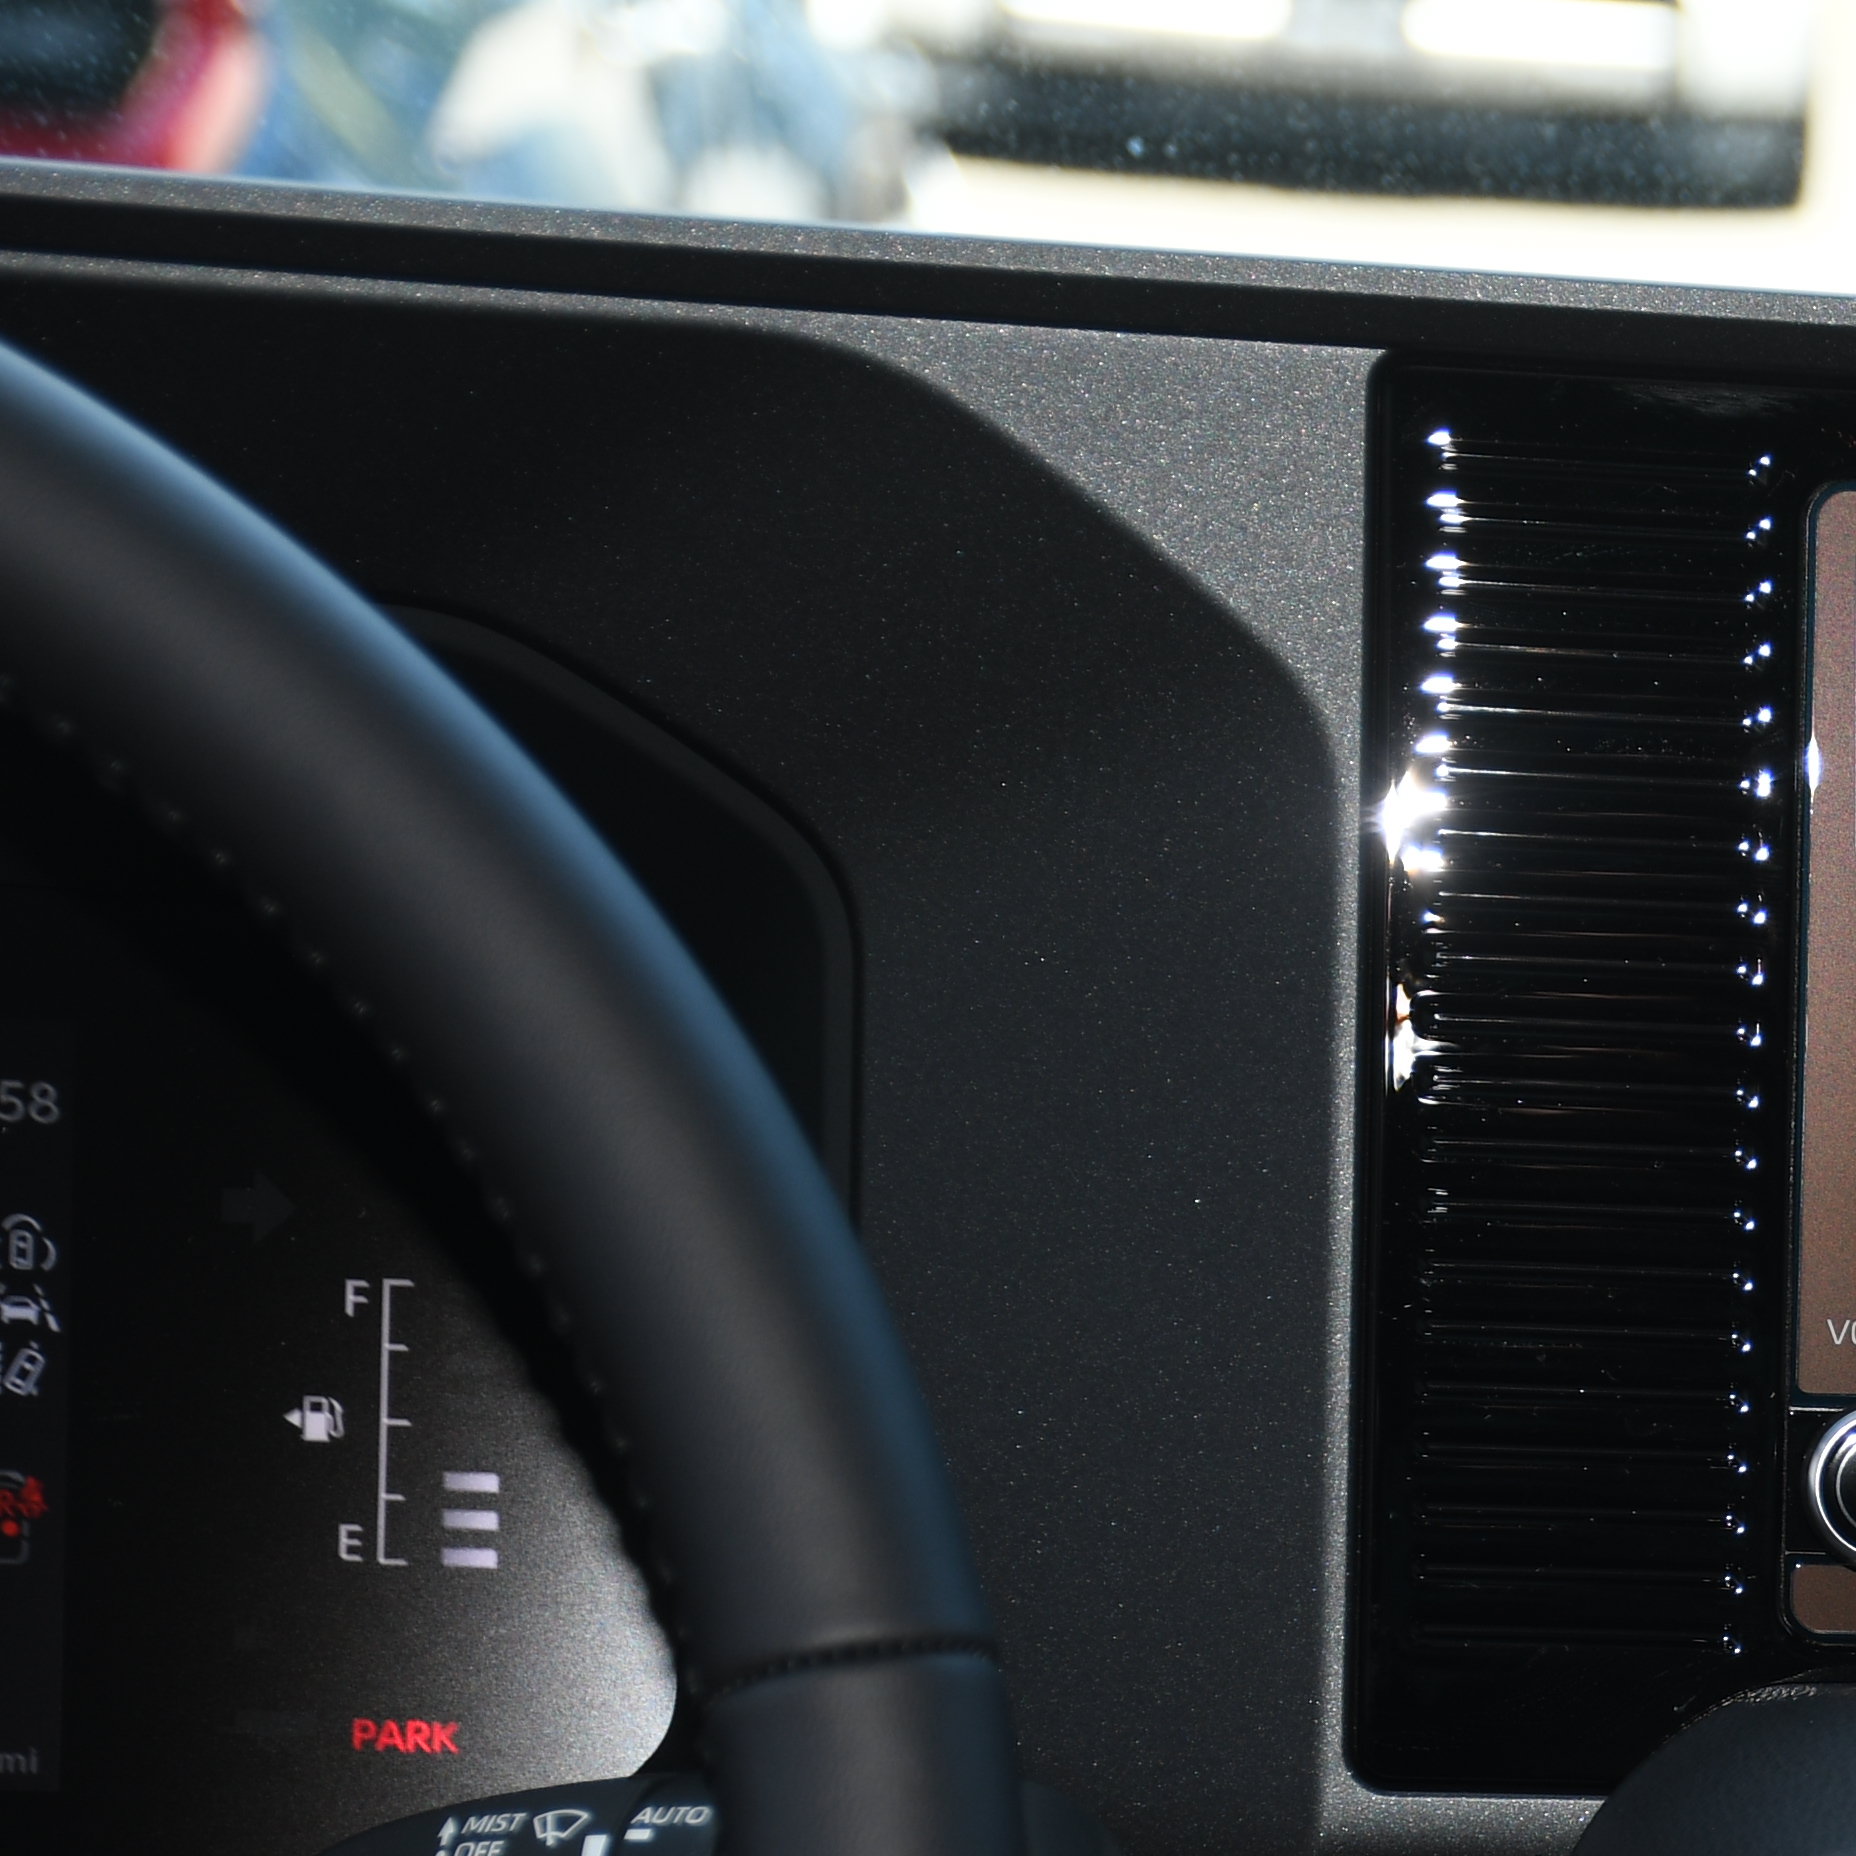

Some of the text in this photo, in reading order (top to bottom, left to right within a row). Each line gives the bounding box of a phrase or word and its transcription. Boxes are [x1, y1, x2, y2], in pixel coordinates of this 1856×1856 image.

[345, 1278, 370, 1316] F
[338, 1524, 363, 1562] E
[352, 1718, 460, 1754] PARK
[460, 1812, 526, 1834] MIST
[630, 1806, 712, 1824] AUTO
